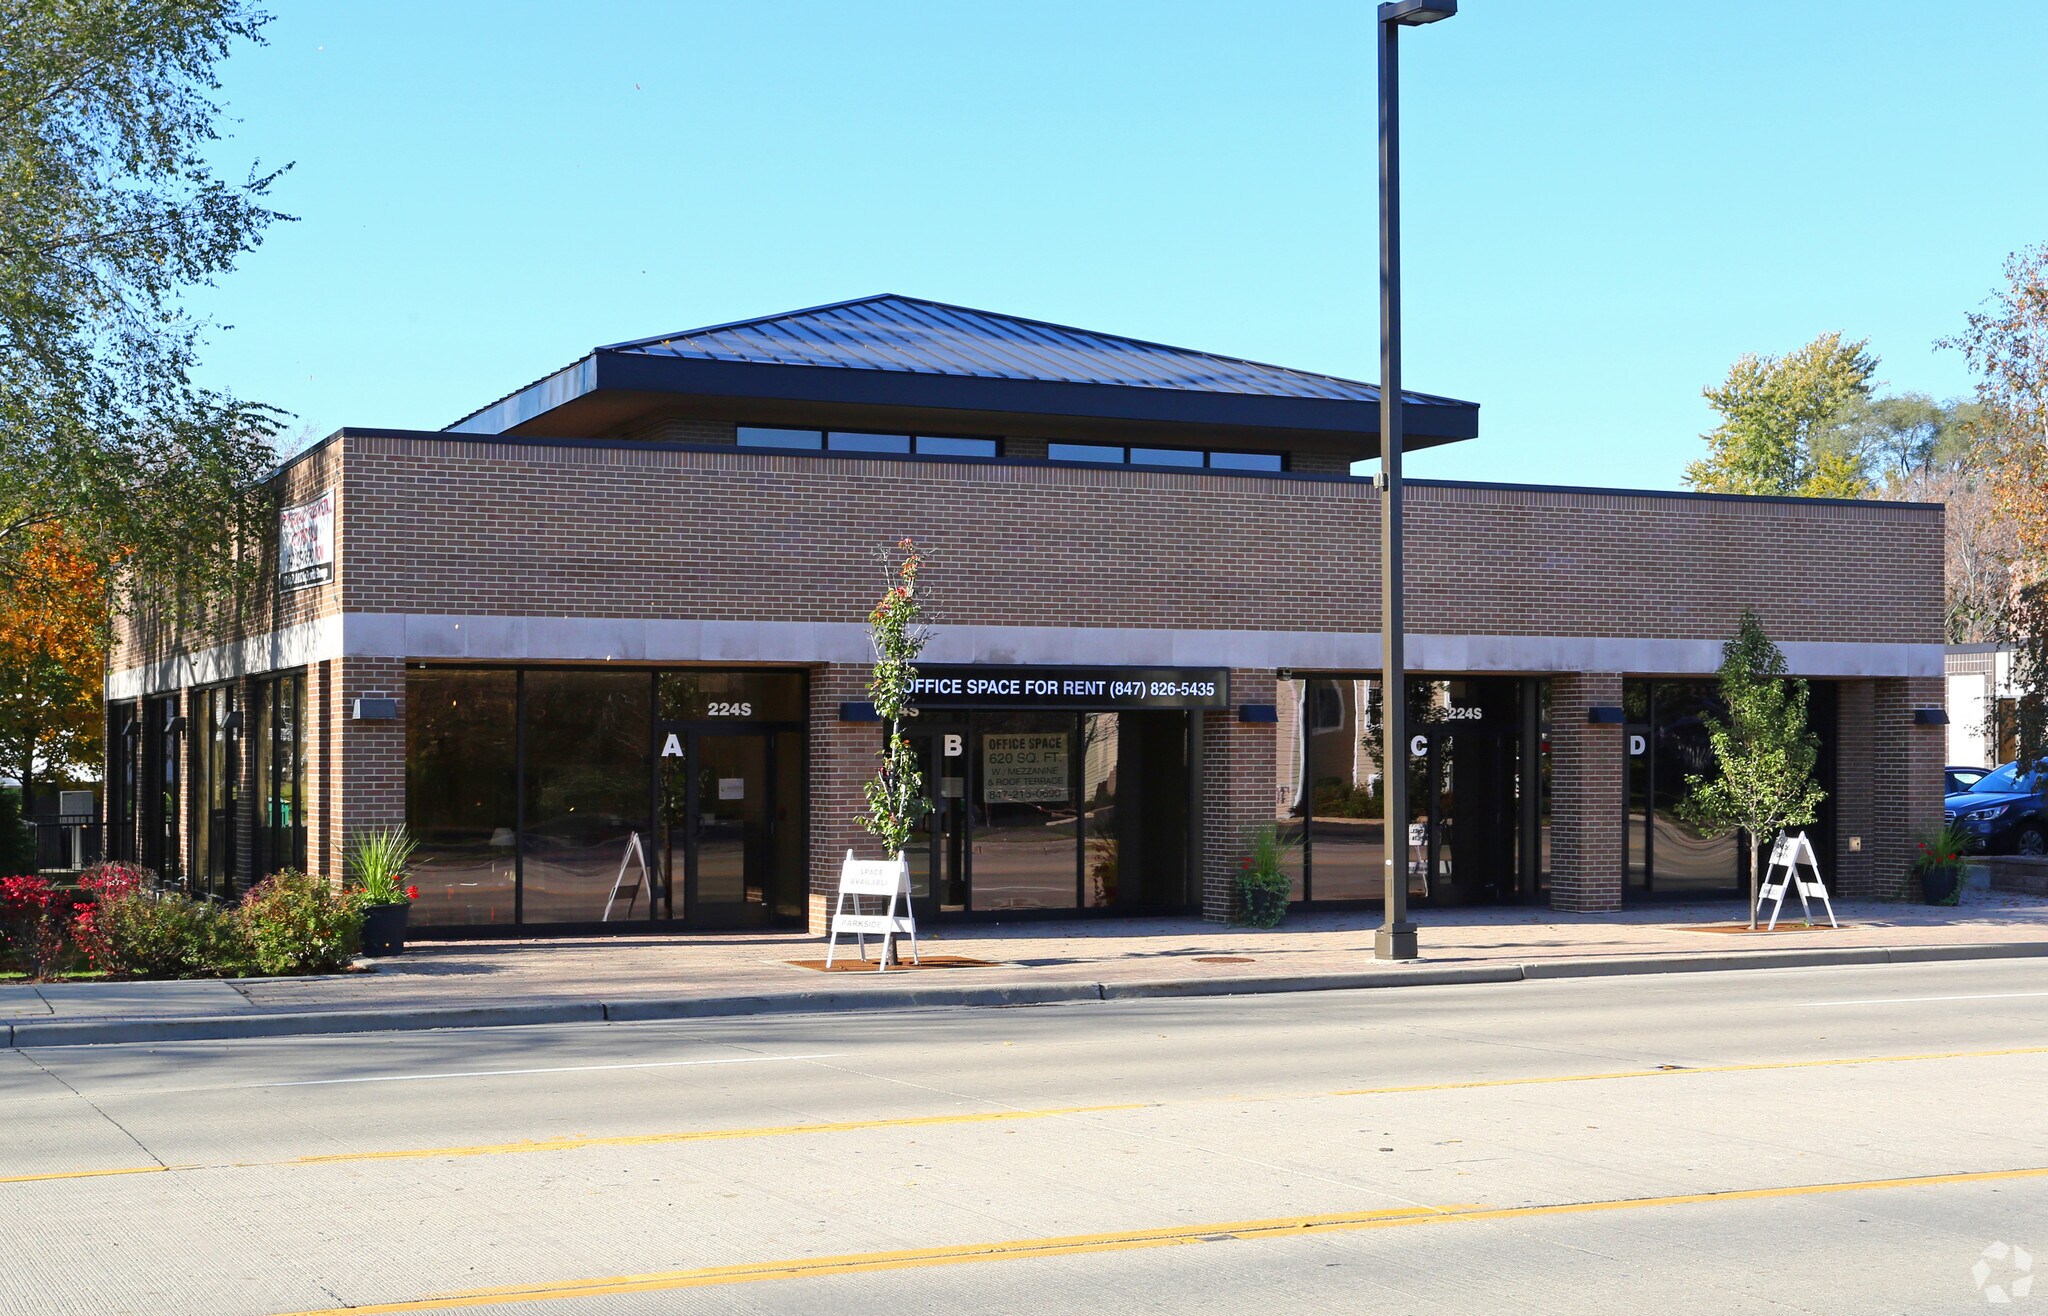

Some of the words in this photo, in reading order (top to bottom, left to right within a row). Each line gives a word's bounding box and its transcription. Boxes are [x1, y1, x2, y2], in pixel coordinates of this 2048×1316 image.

[903, 678, 962, 694] OFFICE
[966, 679, 1020, 695] SPACE
[1025, 680, 1059, 695] FOR
[1063, 680, 1106, 695] RENT
[1109, 681, 1147, 699] (847)
[1150, 682, 1215, 696] 826-5435
[707, 702, 752, 716] 224S
[1448, 707, 1483, 720] 224S
[661, 733, 684, 757] A
[944, 734, 963, 757] B
[988, 738, 1026, 750] OFFICE
[1029, 737, 1062, 750] SPACE
[1410, 735, 1428, 757] C
[1630, 735, 1646, 755] D
[989, 753, 1013, 764] 620
[1017, 752, 1039, 763] SQ.
[1044, 752, 1062, 763] FT.
[1007, 766, 1059, 775] MEZZANINE
[996, 778, 1021, 786] ROOF
[1024, 776, 1064, 785] TERRACE
[860, 868, 884, 876] SPACE
[841, 919, 882, 928] PARKSIDE
